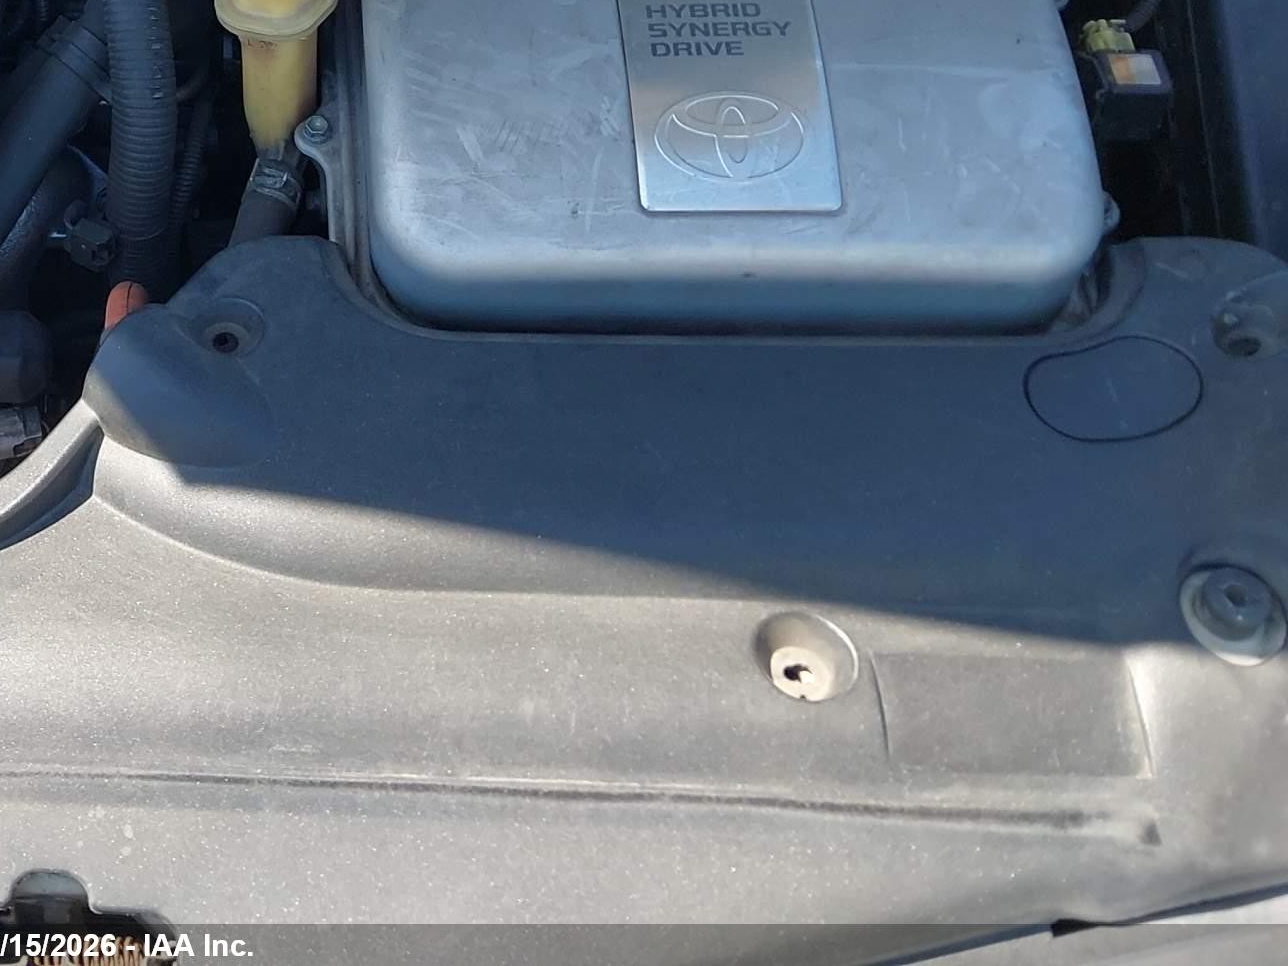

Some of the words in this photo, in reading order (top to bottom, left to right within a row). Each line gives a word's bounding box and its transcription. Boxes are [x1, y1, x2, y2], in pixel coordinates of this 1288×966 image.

[645, 2, 761, 19] HYBRID
[647, 21, 791, 38] SYNERGY
[650, 41, 745, 57] DRIVE
